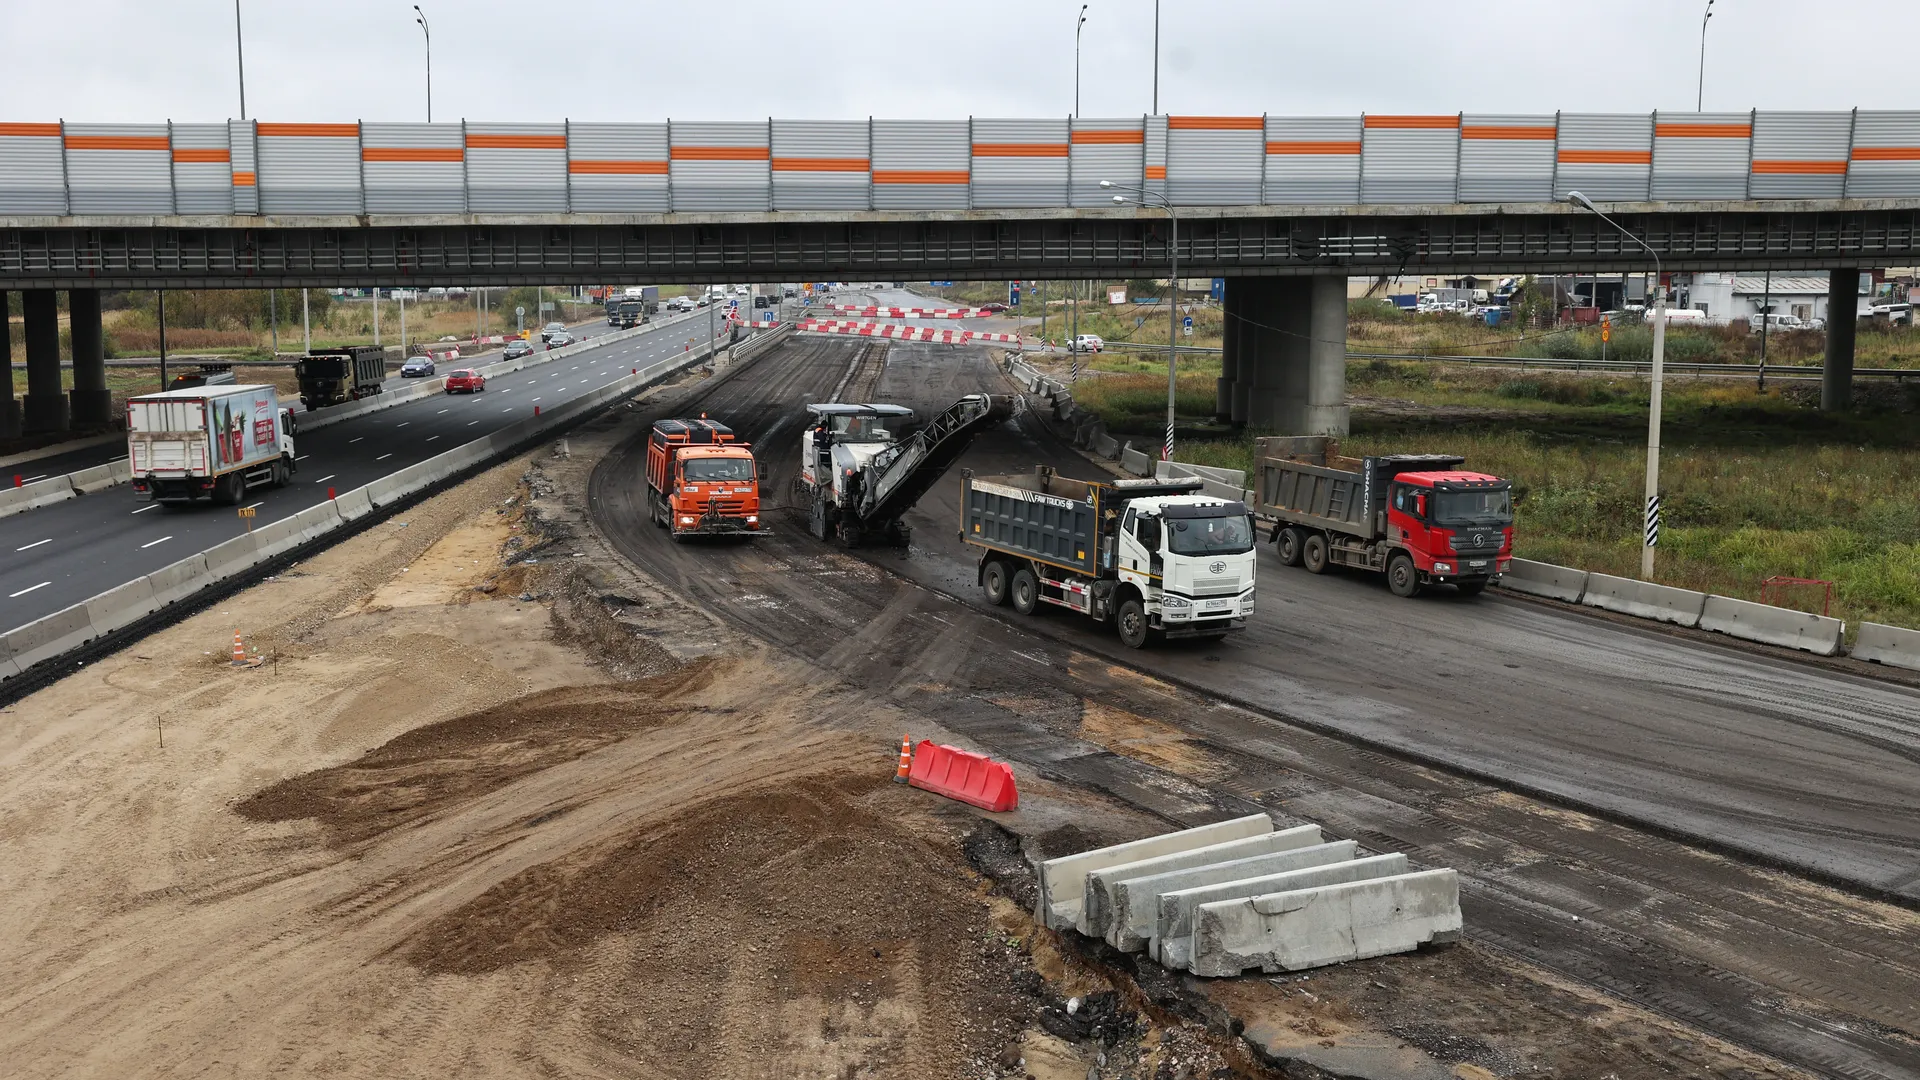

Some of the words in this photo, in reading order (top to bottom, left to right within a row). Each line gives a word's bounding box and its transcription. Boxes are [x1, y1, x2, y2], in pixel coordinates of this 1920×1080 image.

[1034, 494, 1046, 505] FAW
[1046, 497, 1066, 508] TRUCKS
[1363, 470, 1371, 523] SHACMAN
